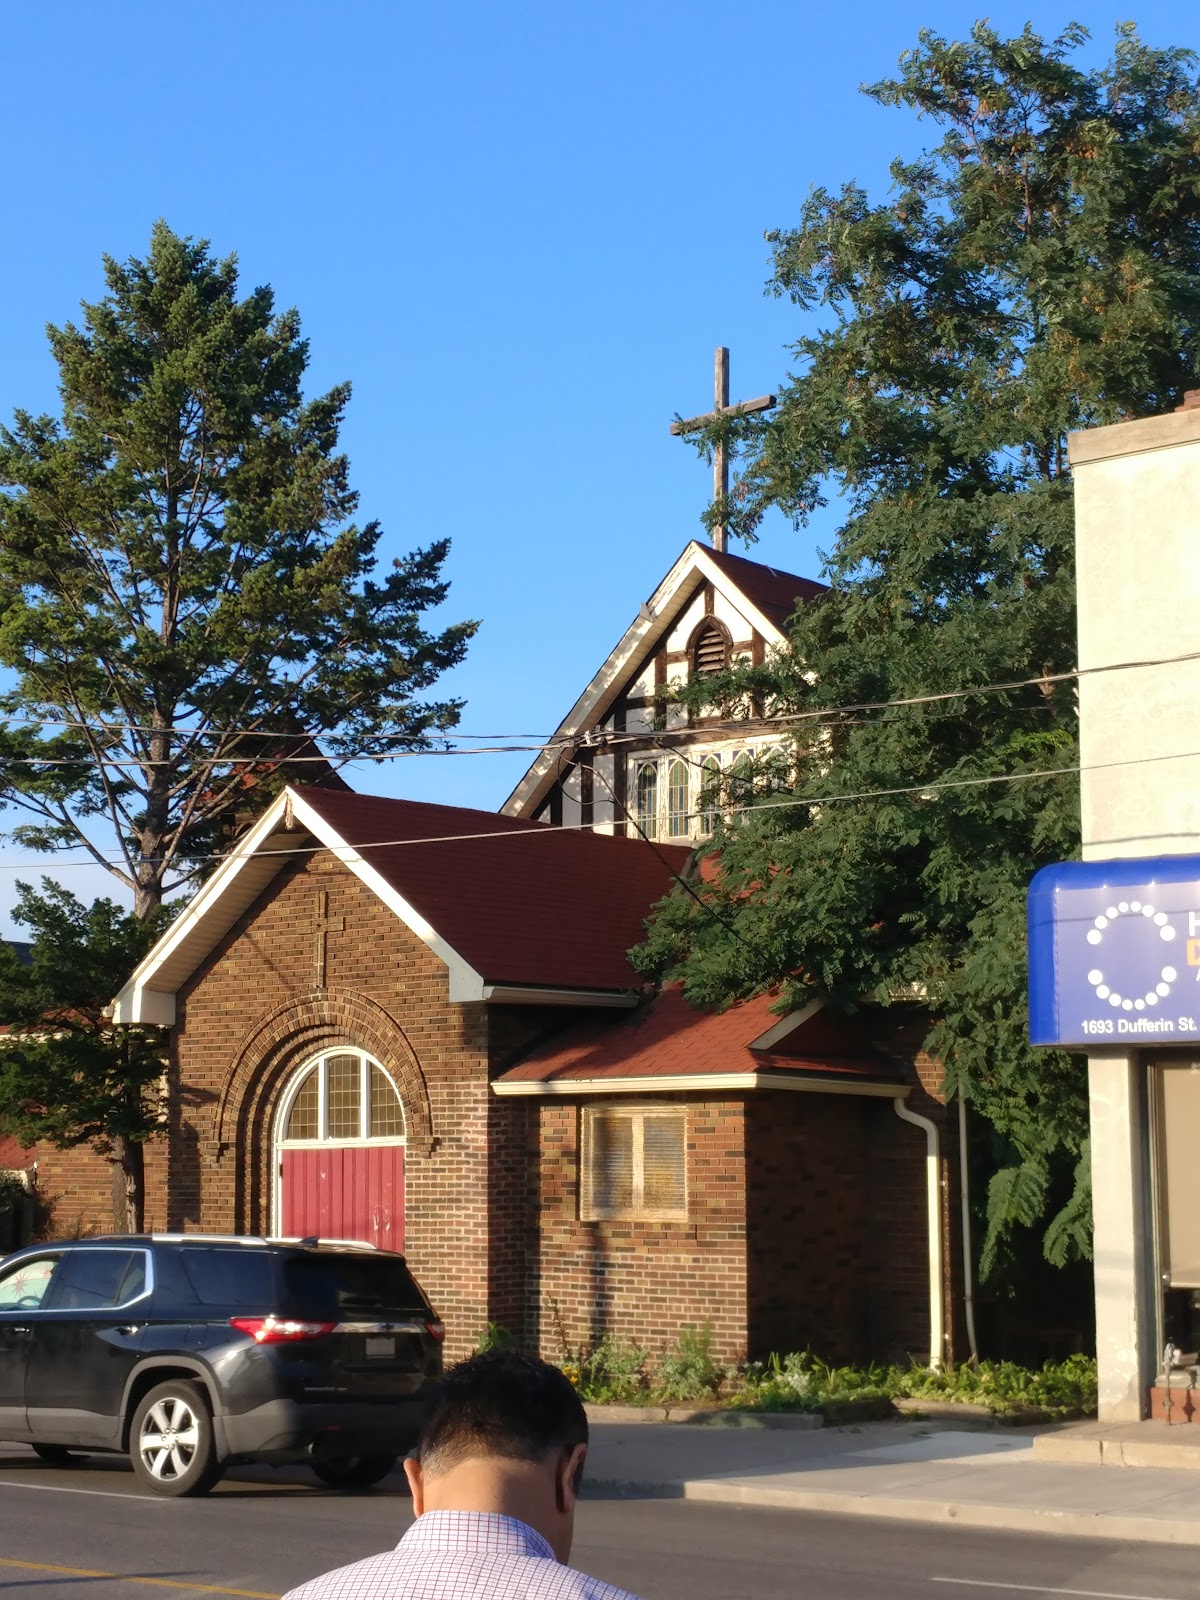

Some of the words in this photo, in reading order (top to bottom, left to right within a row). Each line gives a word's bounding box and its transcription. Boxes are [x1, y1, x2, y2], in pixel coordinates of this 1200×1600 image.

[1081, 1019, 1113, 1034] 1693
[1118, 1018, 1173, 1033] Dufferin
[1178, 1017, 1197, 1031] St.
